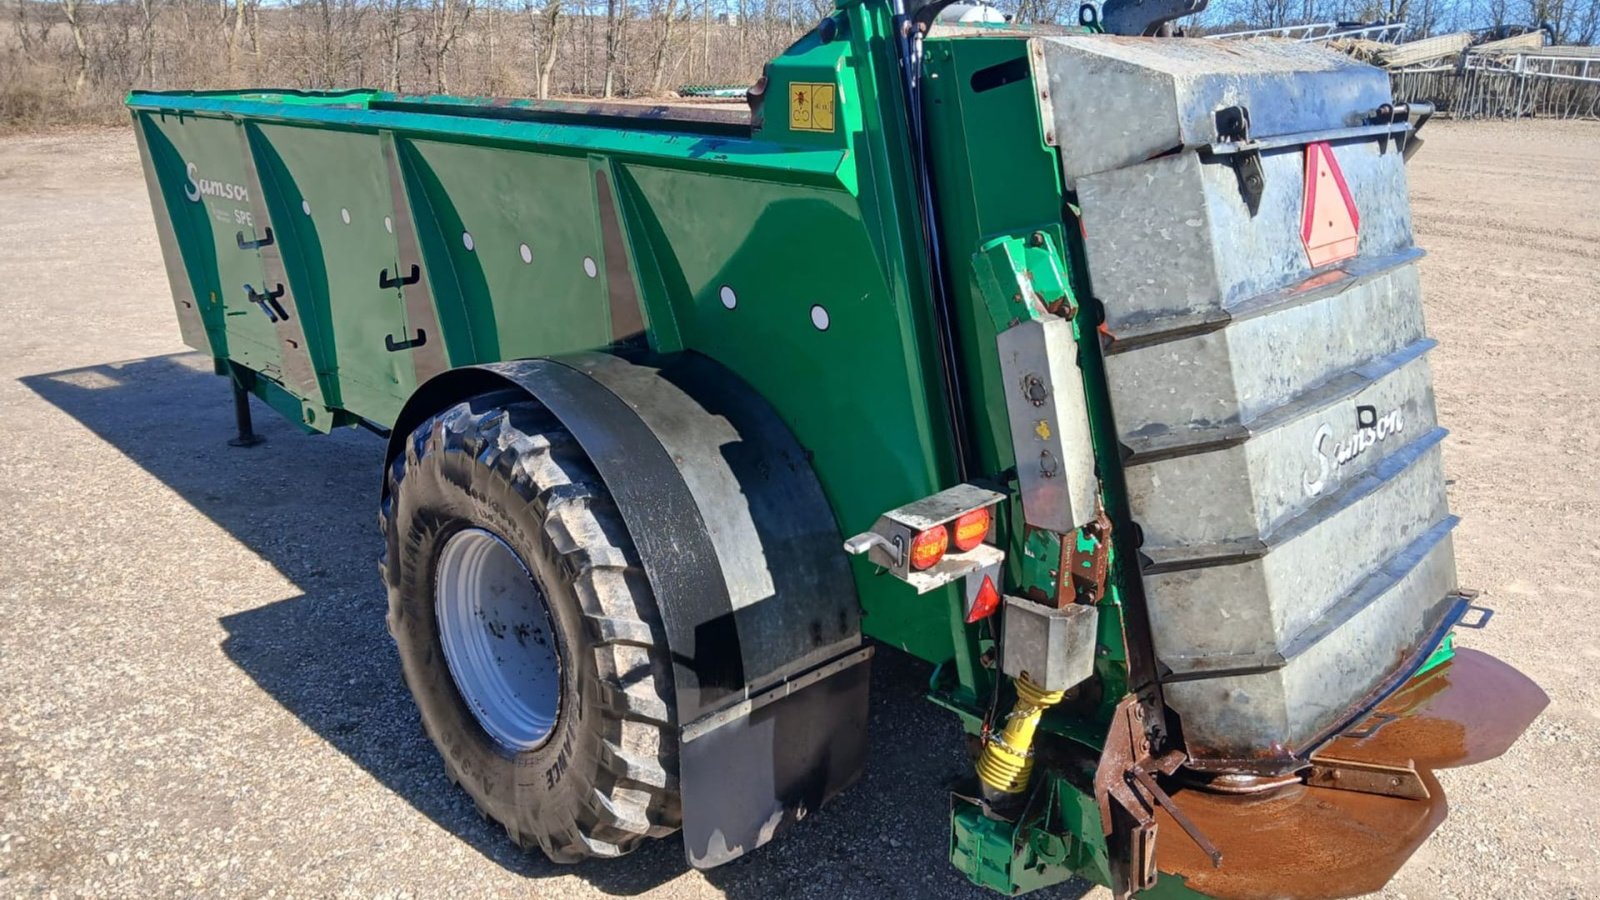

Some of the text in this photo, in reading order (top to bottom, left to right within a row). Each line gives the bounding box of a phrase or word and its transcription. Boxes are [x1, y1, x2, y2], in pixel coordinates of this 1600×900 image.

[184, 161, 249, 203] Samson
[234, 209, 253, 227] SPE
[1303, 410, 1404, 497] Samson
